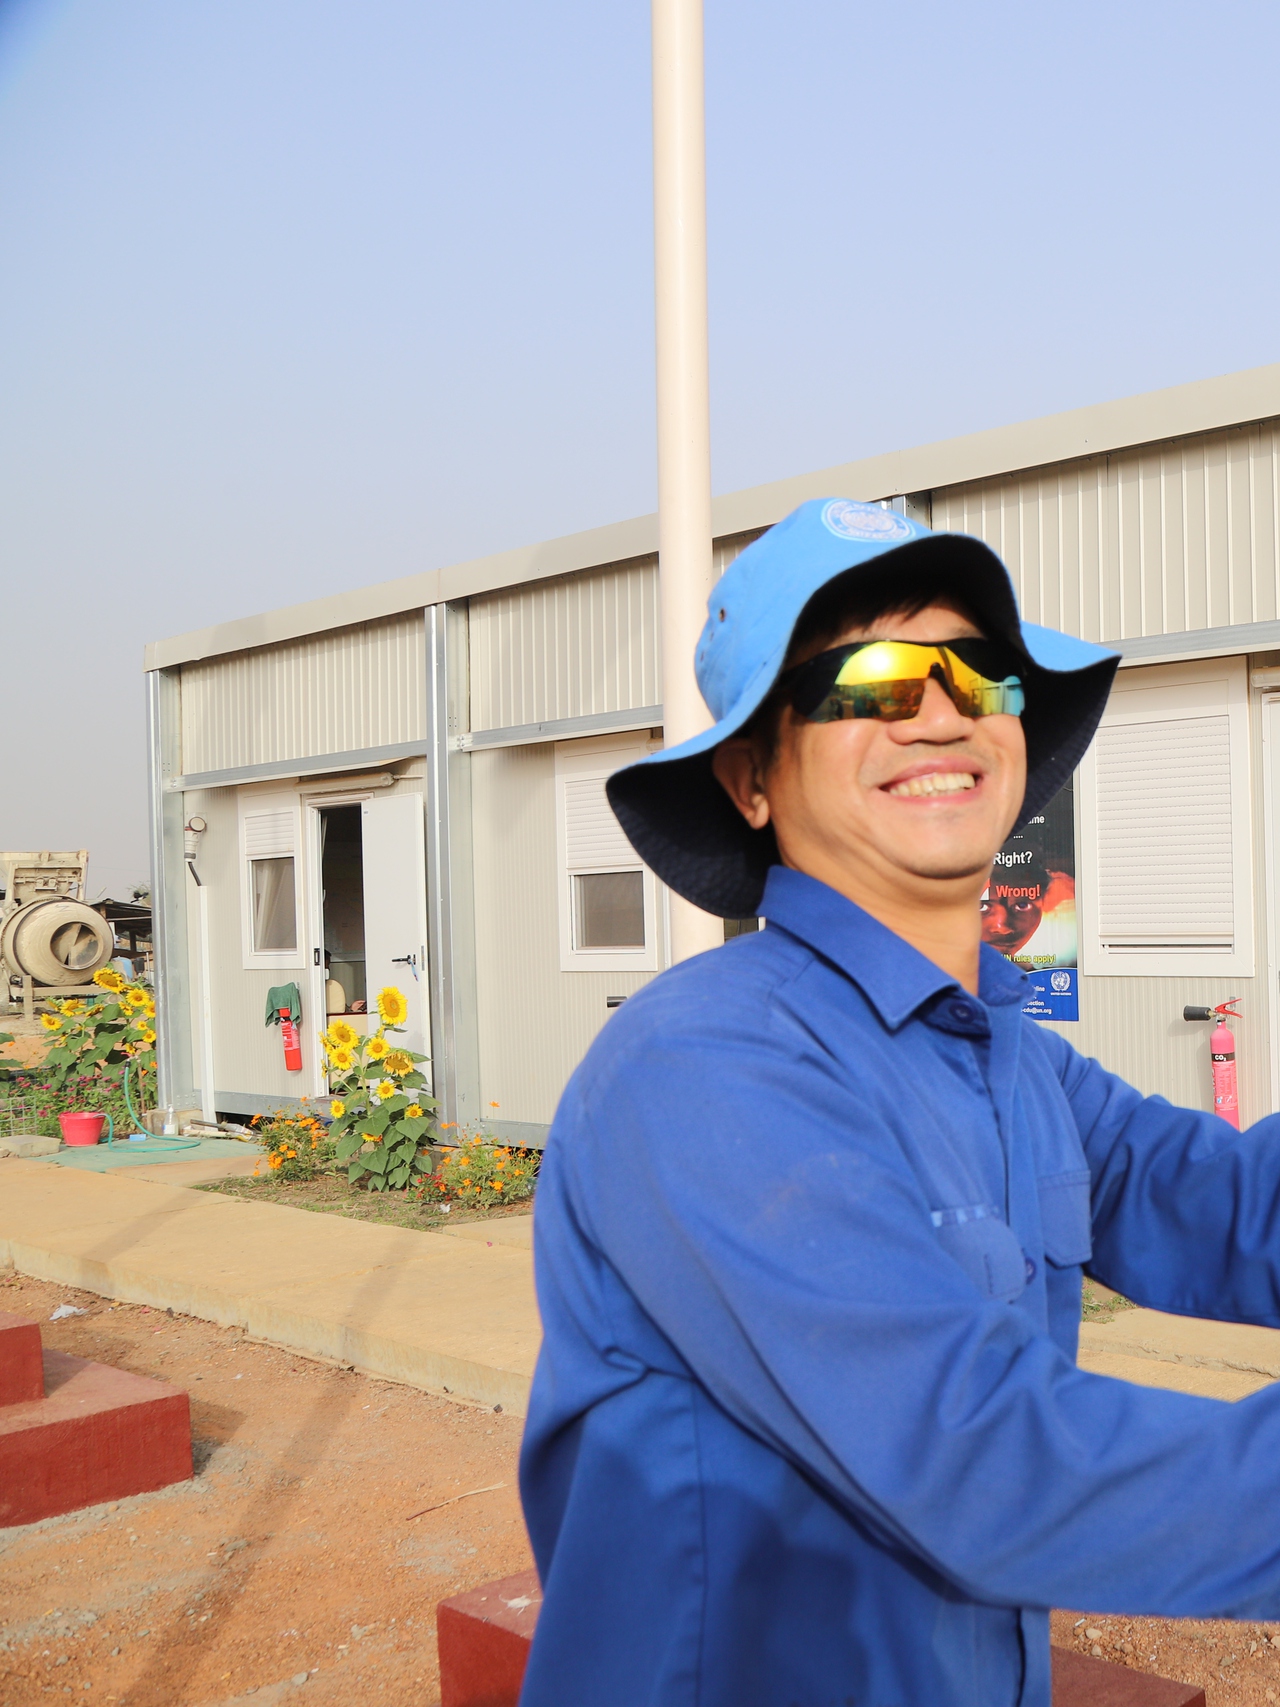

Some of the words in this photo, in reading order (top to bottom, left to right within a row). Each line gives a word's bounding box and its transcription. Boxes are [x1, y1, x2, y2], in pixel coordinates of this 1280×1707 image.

[993, 851, 1033, 867] Right?
[995, 884, 1041, 900] Wrong!
[1013, 954, 1032, 963] rules
[1033, 954, 1056, 965] apply!
